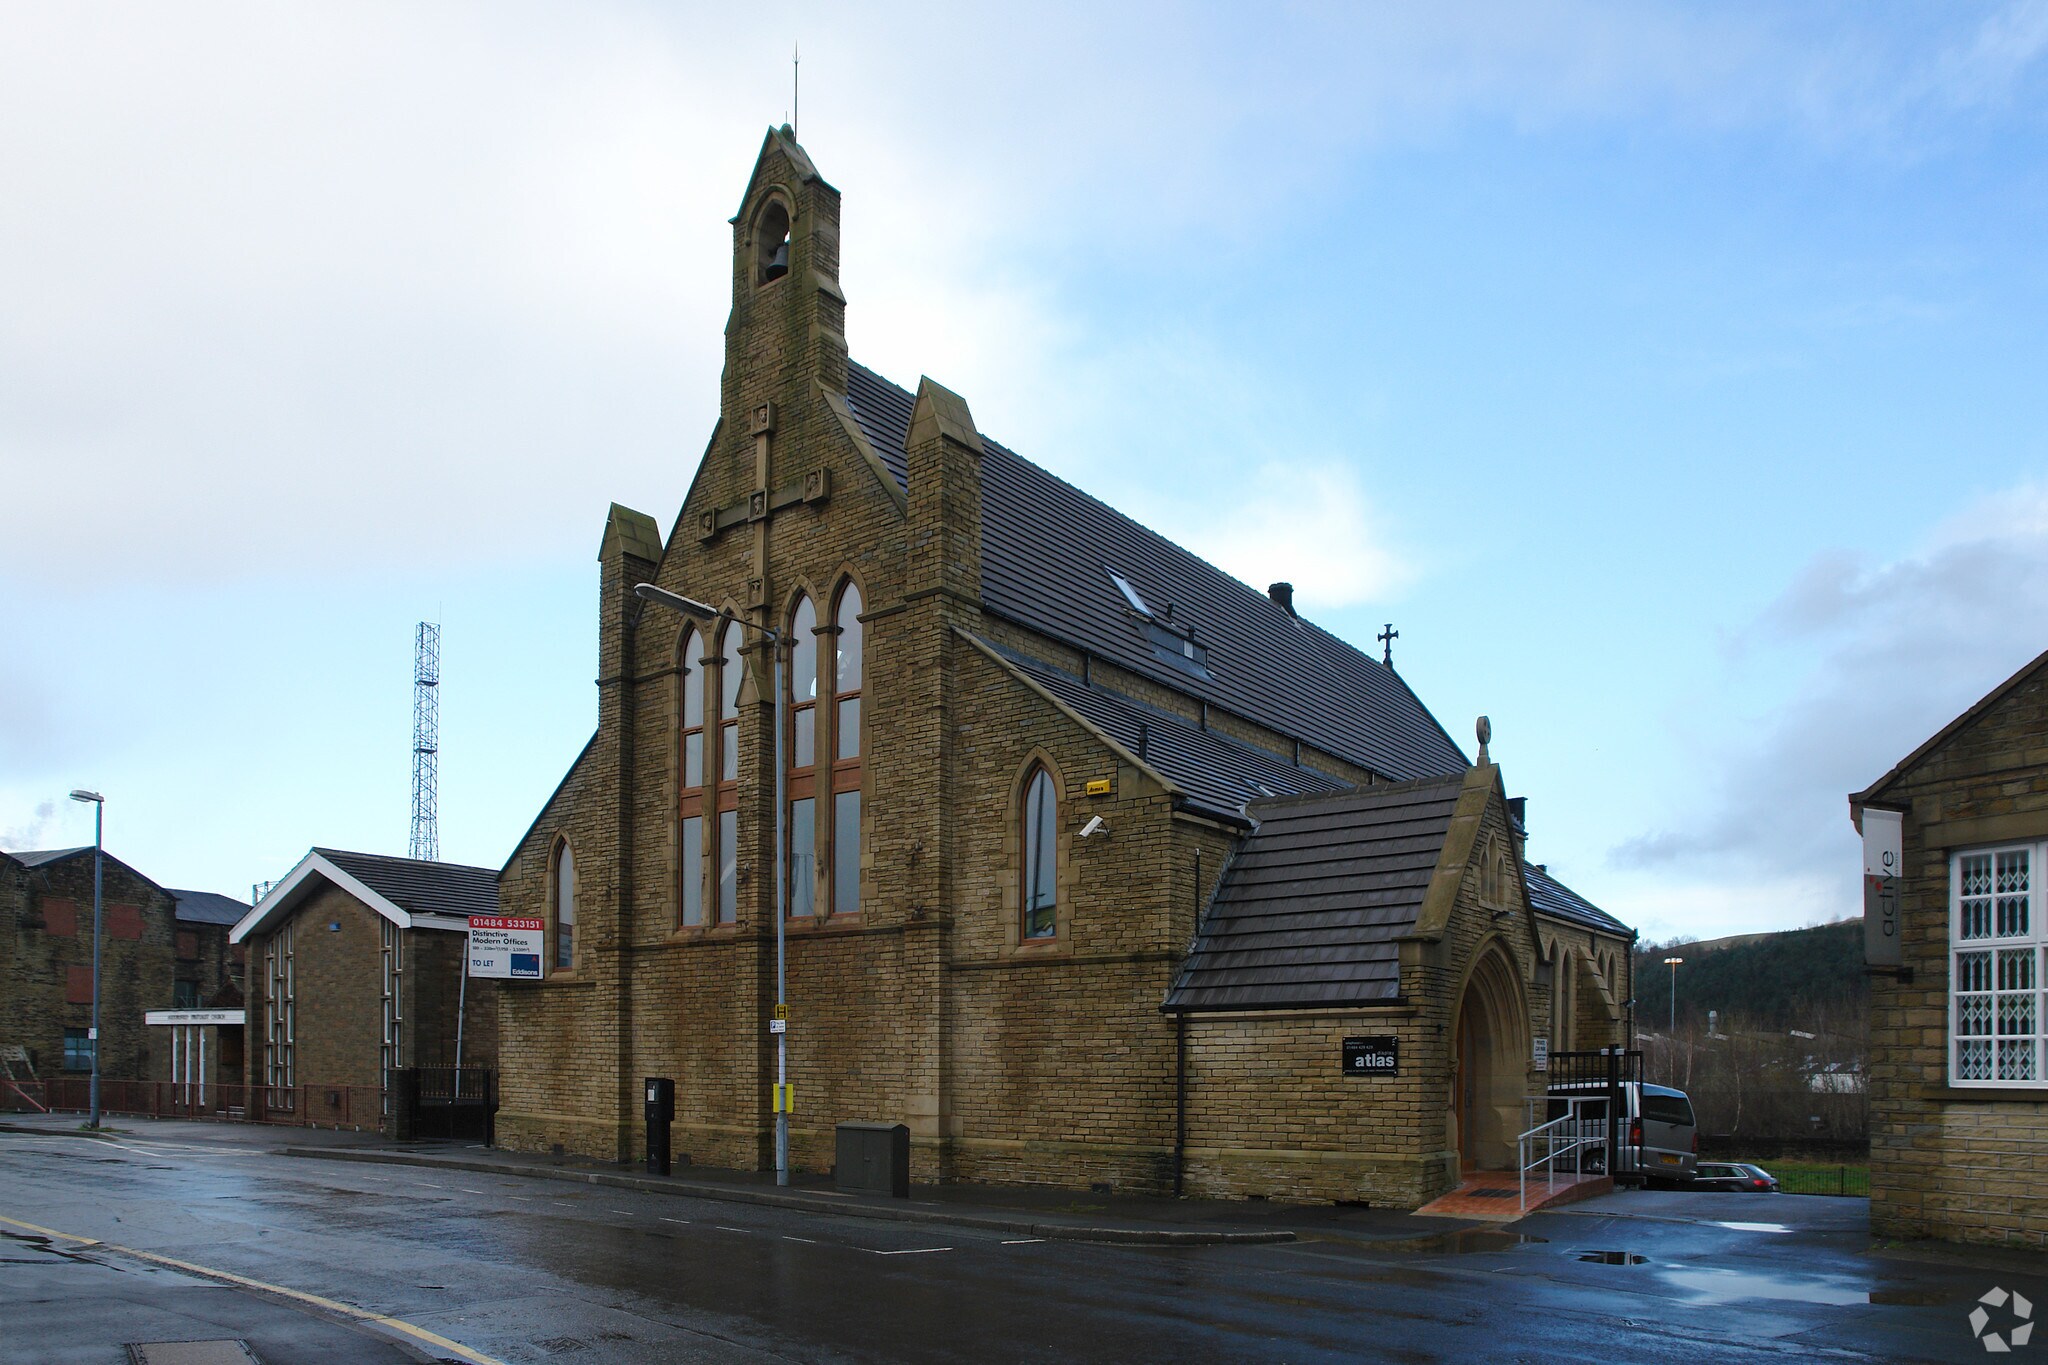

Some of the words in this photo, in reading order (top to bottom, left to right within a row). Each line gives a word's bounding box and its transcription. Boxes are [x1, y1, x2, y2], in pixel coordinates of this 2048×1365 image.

[1879, 850, 1894, 937] active
[473, 918, 503, 927] 01484
[507, 919, 540, 929] 533151
[472, 929, 509, 938] Distinctive
[472, 937, 501, 945] Modern
[503, 938, 528, 946] Offices
[472, 959, 481, 967] TO
[512, 968, 538, 976] Eddisons
[1355, 1053, 1395, 1067] atlas
